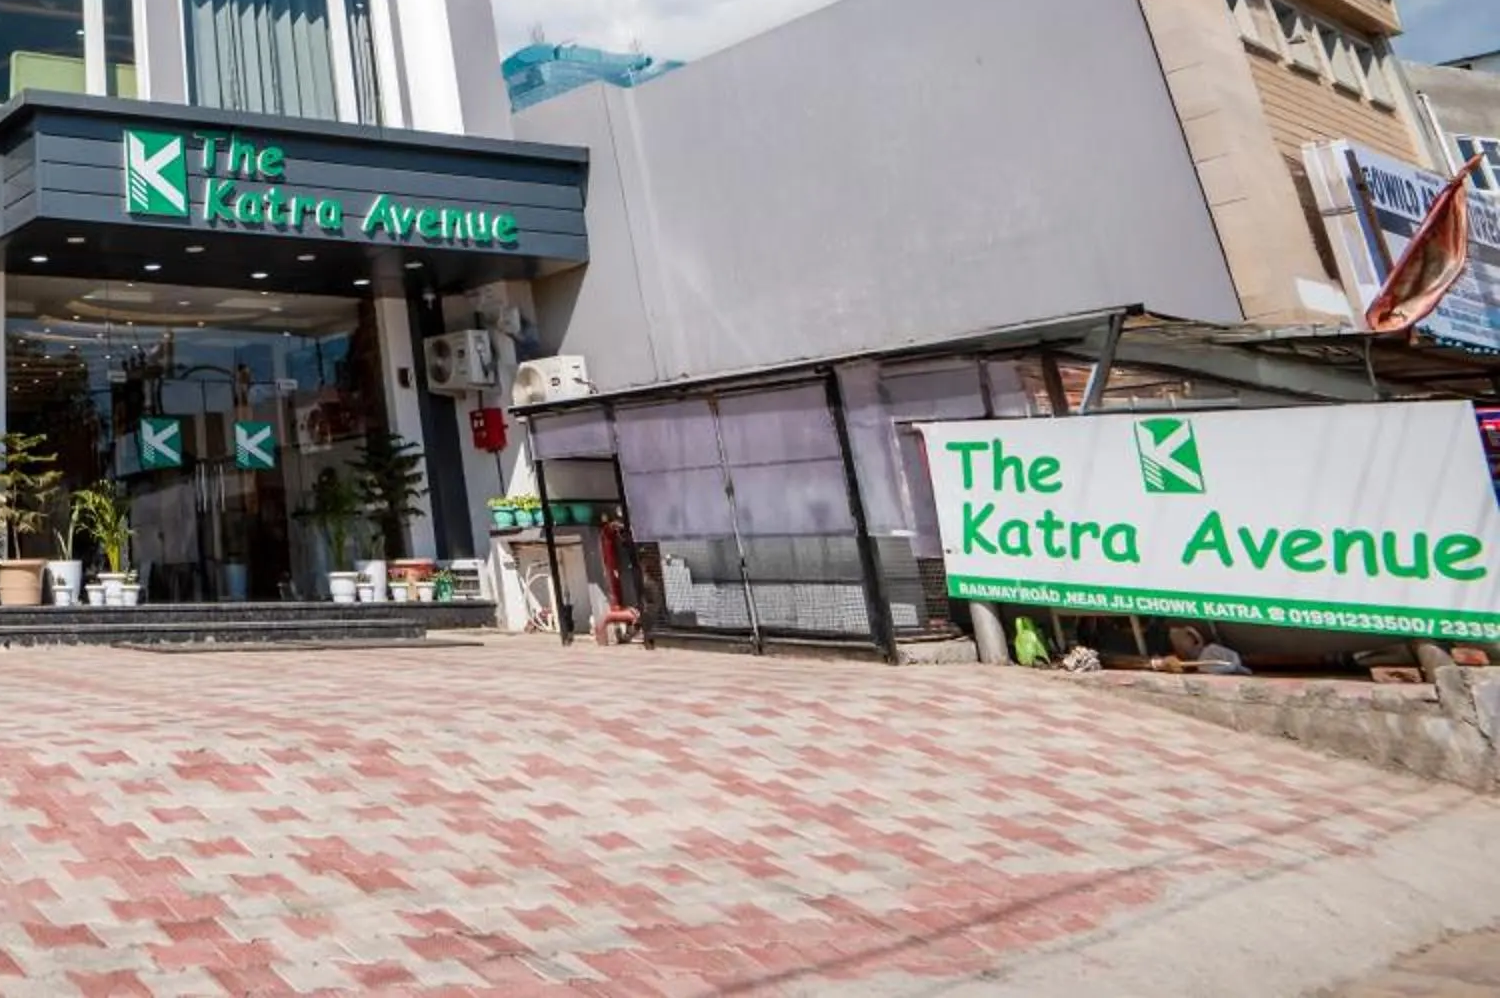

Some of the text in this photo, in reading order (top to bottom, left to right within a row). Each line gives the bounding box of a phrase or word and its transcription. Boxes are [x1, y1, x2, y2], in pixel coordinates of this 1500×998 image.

[194, 133, 286, 177] The
[204, 178, 519, 244] Katra Avenue
[944, 438, 1062, 494] The
[961, 501, 1489, 581] Katra Avenue
[959, 582, 1017, 601] RAILWAY
[1018, 586, 1060, 604] ROAD
[1135, 597, 1197, 616] CHOWK
[1202, 601, 1263, 620] KATRA
[1440, 619, 1500, 640] 2335
